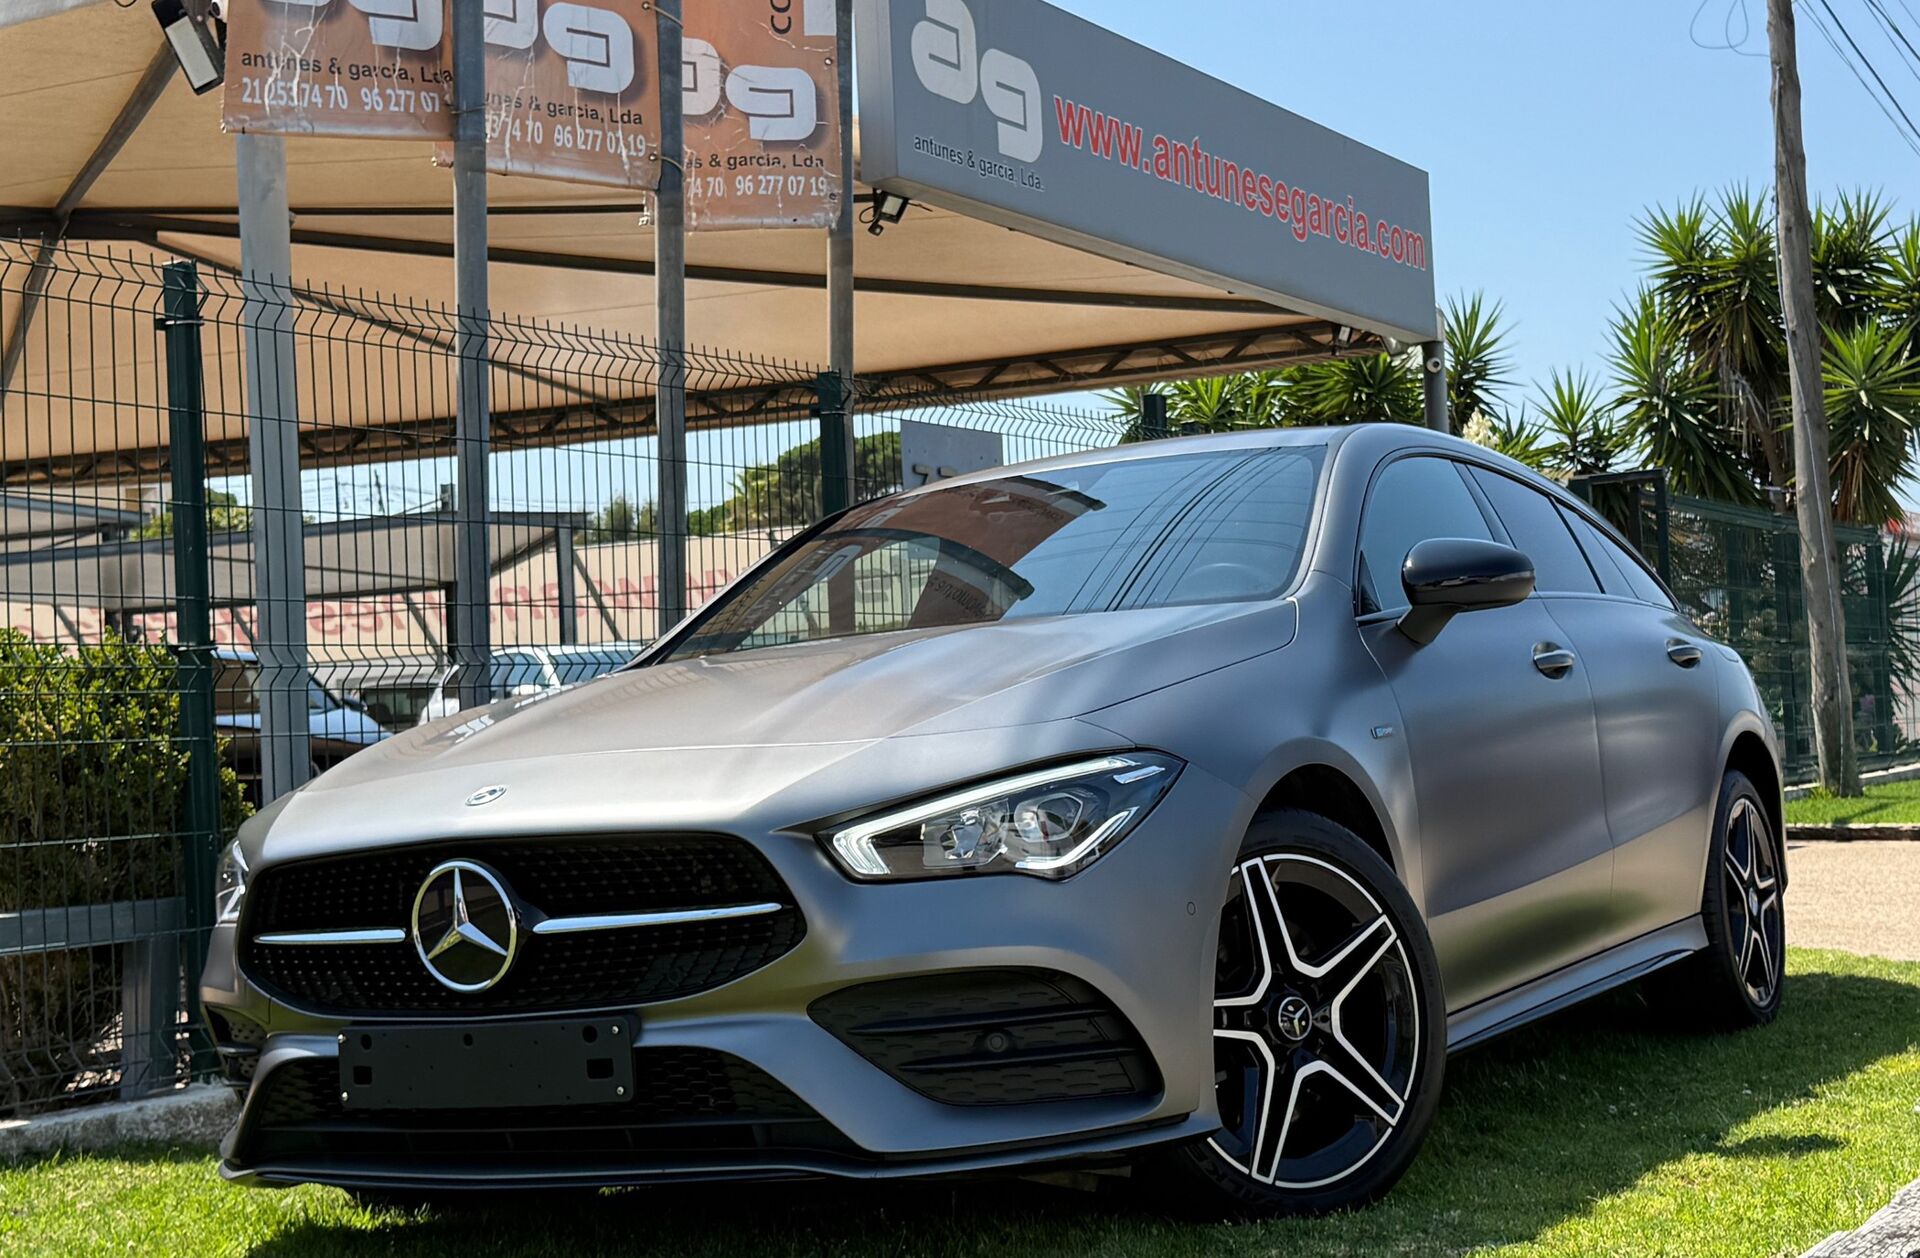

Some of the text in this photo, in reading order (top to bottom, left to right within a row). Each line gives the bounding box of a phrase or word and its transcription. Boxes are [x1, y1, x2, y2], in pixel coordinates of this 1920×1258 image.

[328, 57, 341, 75] &
[242, 77, 262, 104] 21
[300, 82, 322, 108] 74
[326, 85, 348, 110] 70
[361, 87, 383, 111] 96
[386, 88, 415, 113] 277
[420, 91, 440, 113] 07
[610, 108, 643, 125] Lda
[627, 133, 646, 157] 19
[914, 135, 965, 166] antunes
[966, 150, 976, 169] &
[709, 153, 721, 168] &
[706, 176, 724, 198] 70
[735, 174, 754, 197] 96
[758, 174, 784, 196] 277
[788, 175, 806, 197] 07
[810, 175, 827, 197] 19
[1053, 95, 1426, 270] www.antunesegarcia.com
